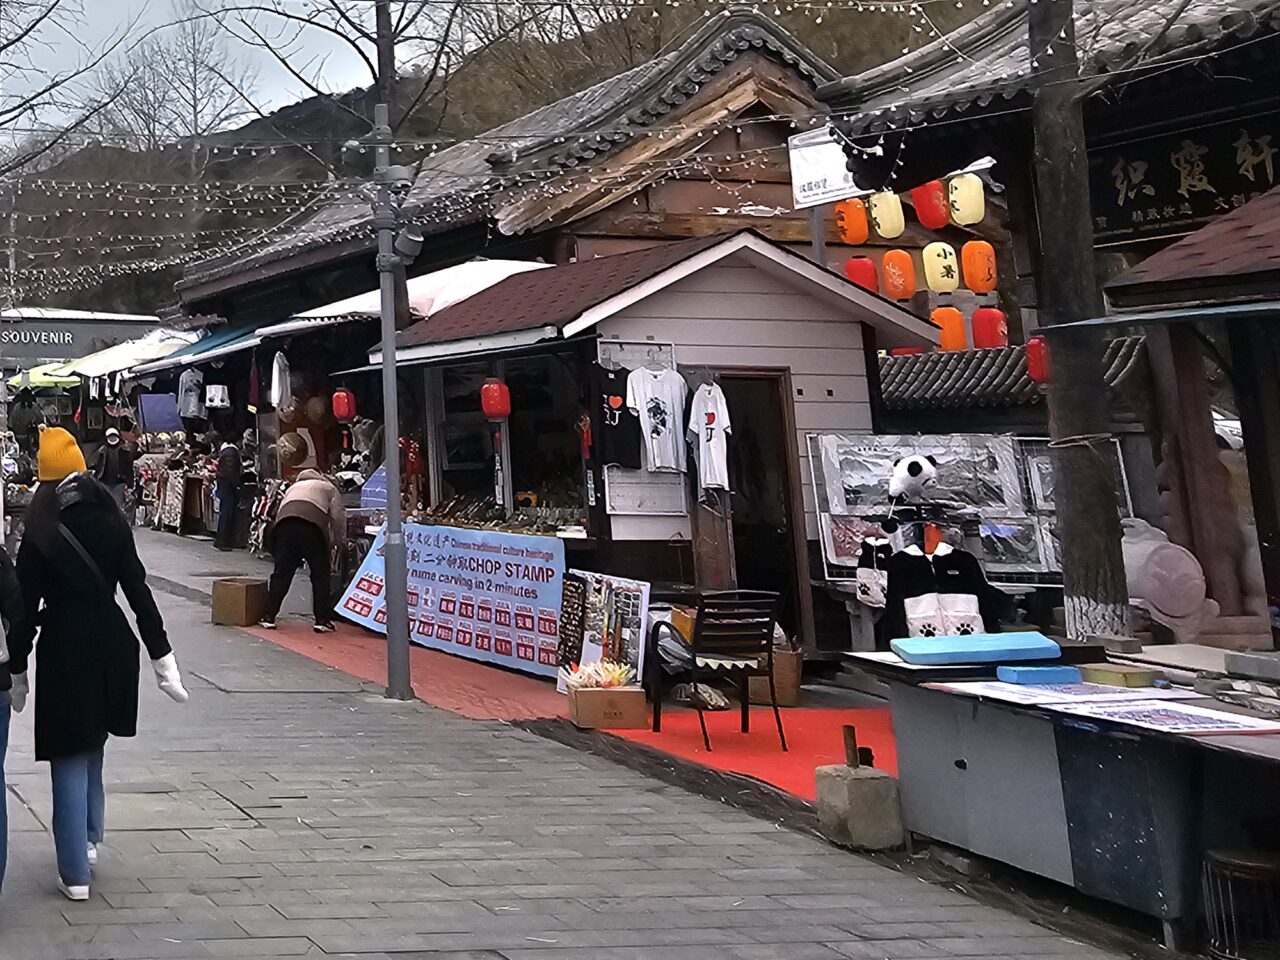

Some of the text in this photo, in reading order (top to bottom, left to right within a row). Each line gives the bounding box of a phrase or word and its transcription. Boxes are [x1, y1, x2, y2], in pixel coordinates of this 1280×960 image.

[1, 331, 73, 344] SOUVENIR
[468, 556, 555, 583] CHOP STAMP
[438, 572, 473, 590] carving
[474, 576, 484, 590] in
[486, 578, 494, 591] 2
[495, 581, 539, 599] minutes
